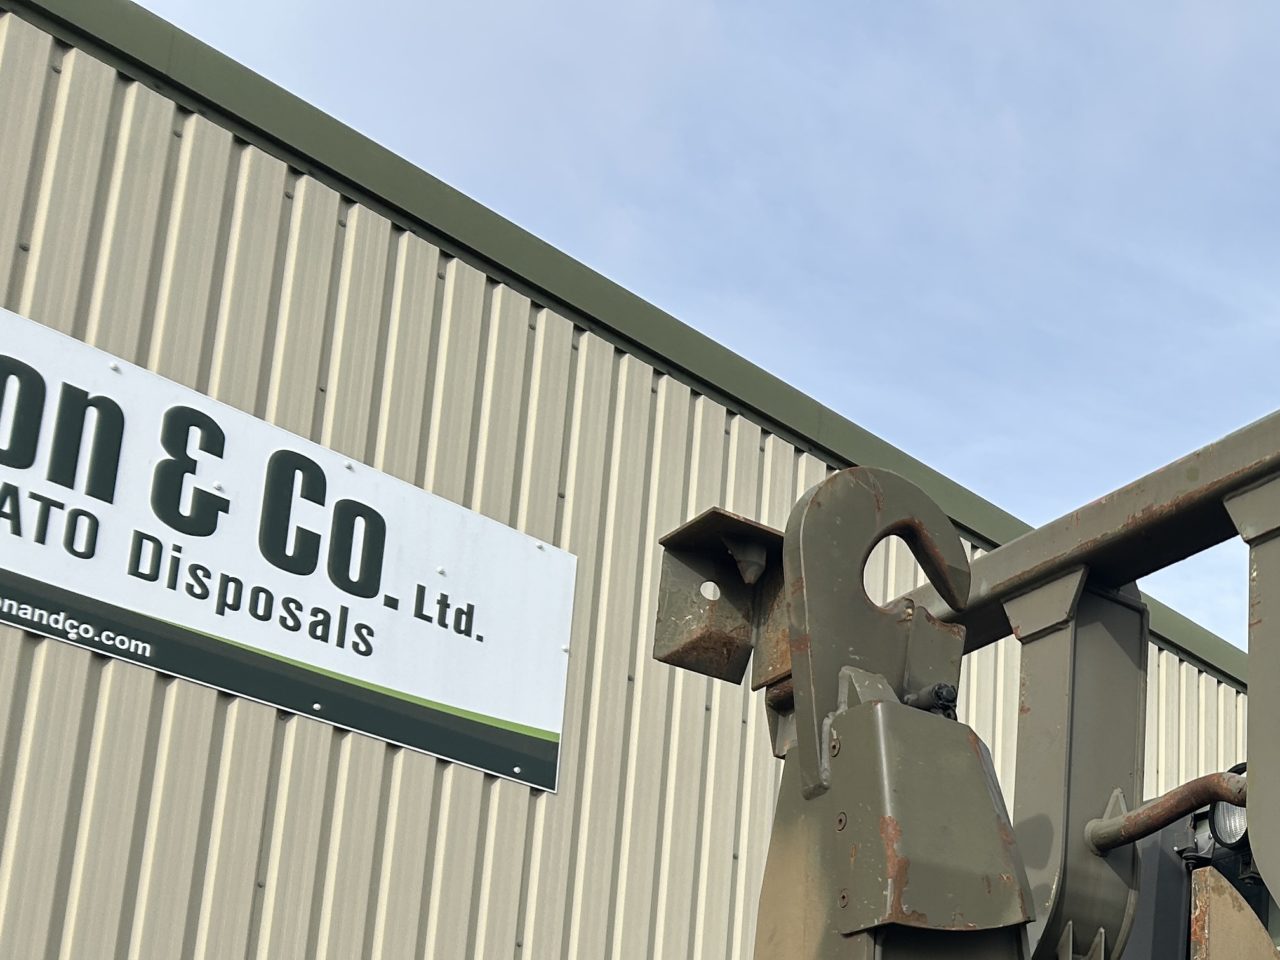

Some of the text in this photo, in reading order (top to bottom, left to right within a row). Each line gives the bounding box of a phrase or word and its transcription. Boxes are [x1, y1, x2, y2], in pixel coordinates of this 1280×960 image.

[0, 354, 485, 643] on & Co. Ltd.
[0, 482, 376, 658] ATO Disposals
[0, 597, 152, 657] nandco.com
